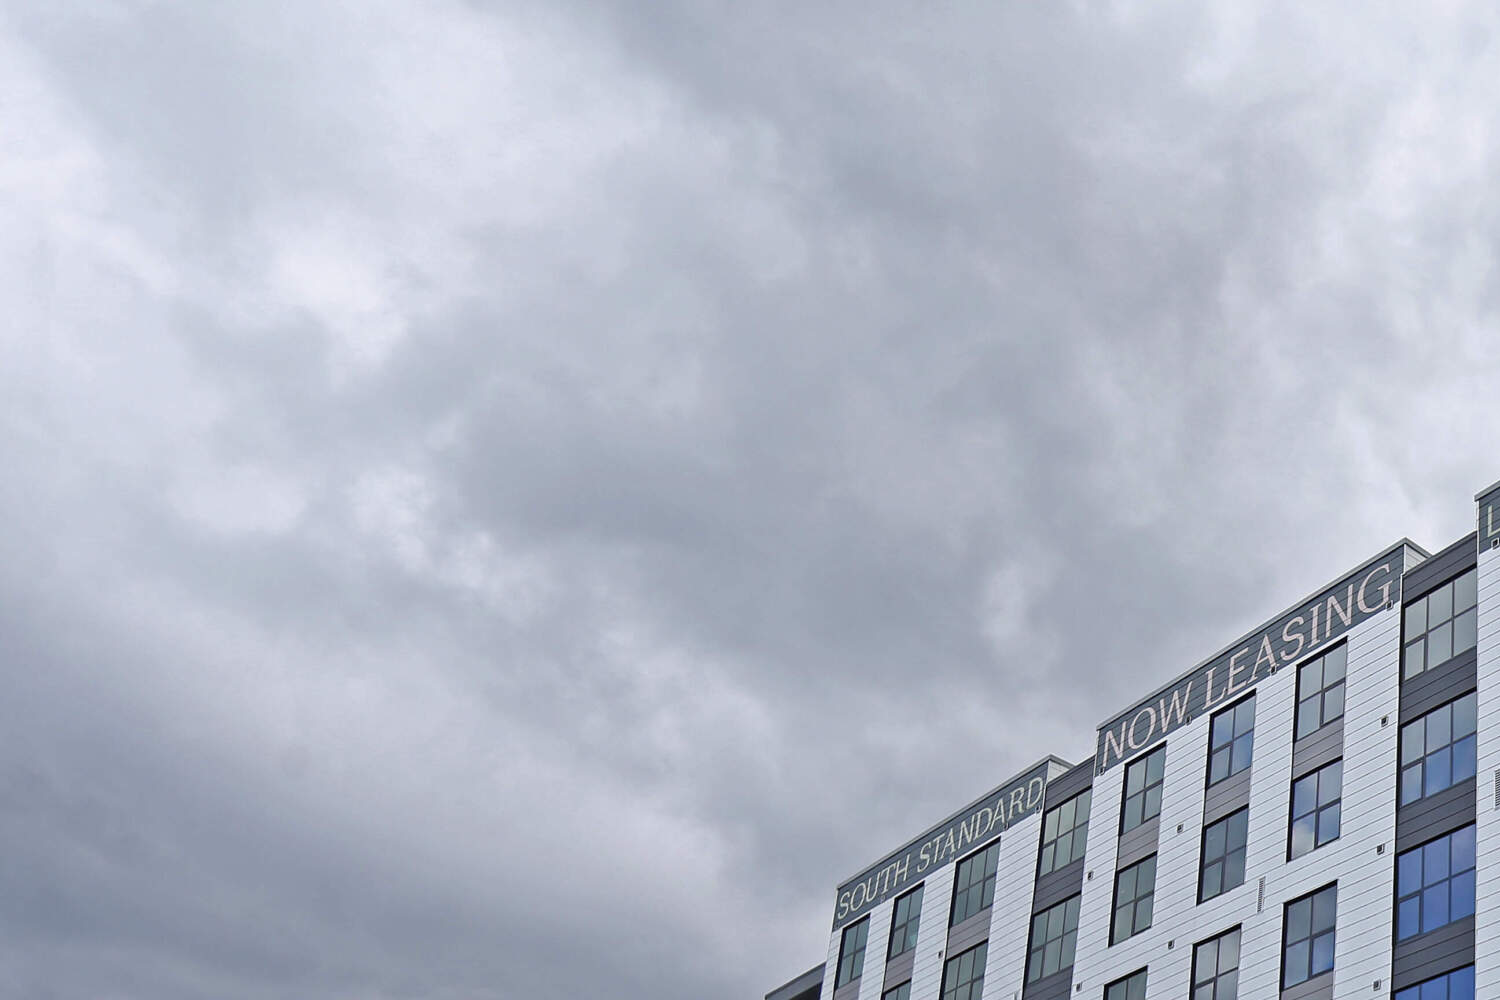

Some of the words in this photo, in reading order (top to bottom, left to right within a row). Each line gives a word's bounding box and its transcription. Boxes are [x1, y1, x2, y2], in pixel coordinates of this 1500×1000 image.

[1102, 681, 1193, 767] NOW
[1202, 563, 1393, 710] LEASING
[837, 854, 910, 920] SOUTH
[917, 776, 1044, 873] STANDARD
